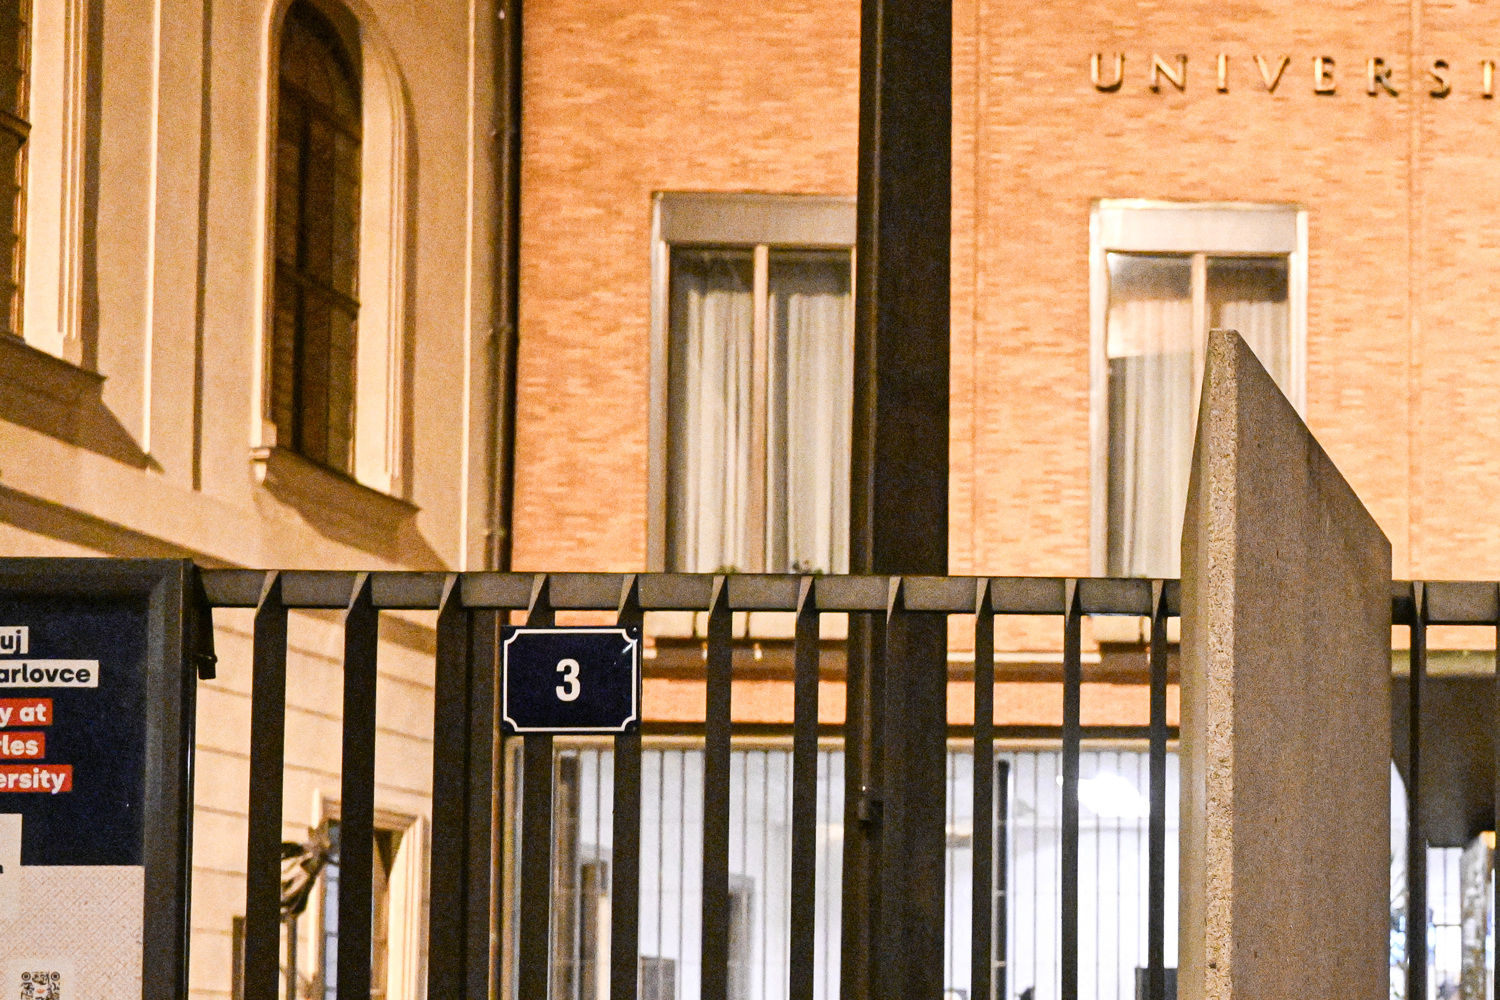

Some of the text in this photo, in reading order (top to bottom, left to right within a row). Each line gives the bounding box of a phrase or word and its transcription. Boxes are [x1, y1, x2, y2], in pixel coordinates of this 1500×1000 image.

[555, 658, 581, 702] 3
[19, 703, 47, 722] at
[0, 734, 39, 756] les
